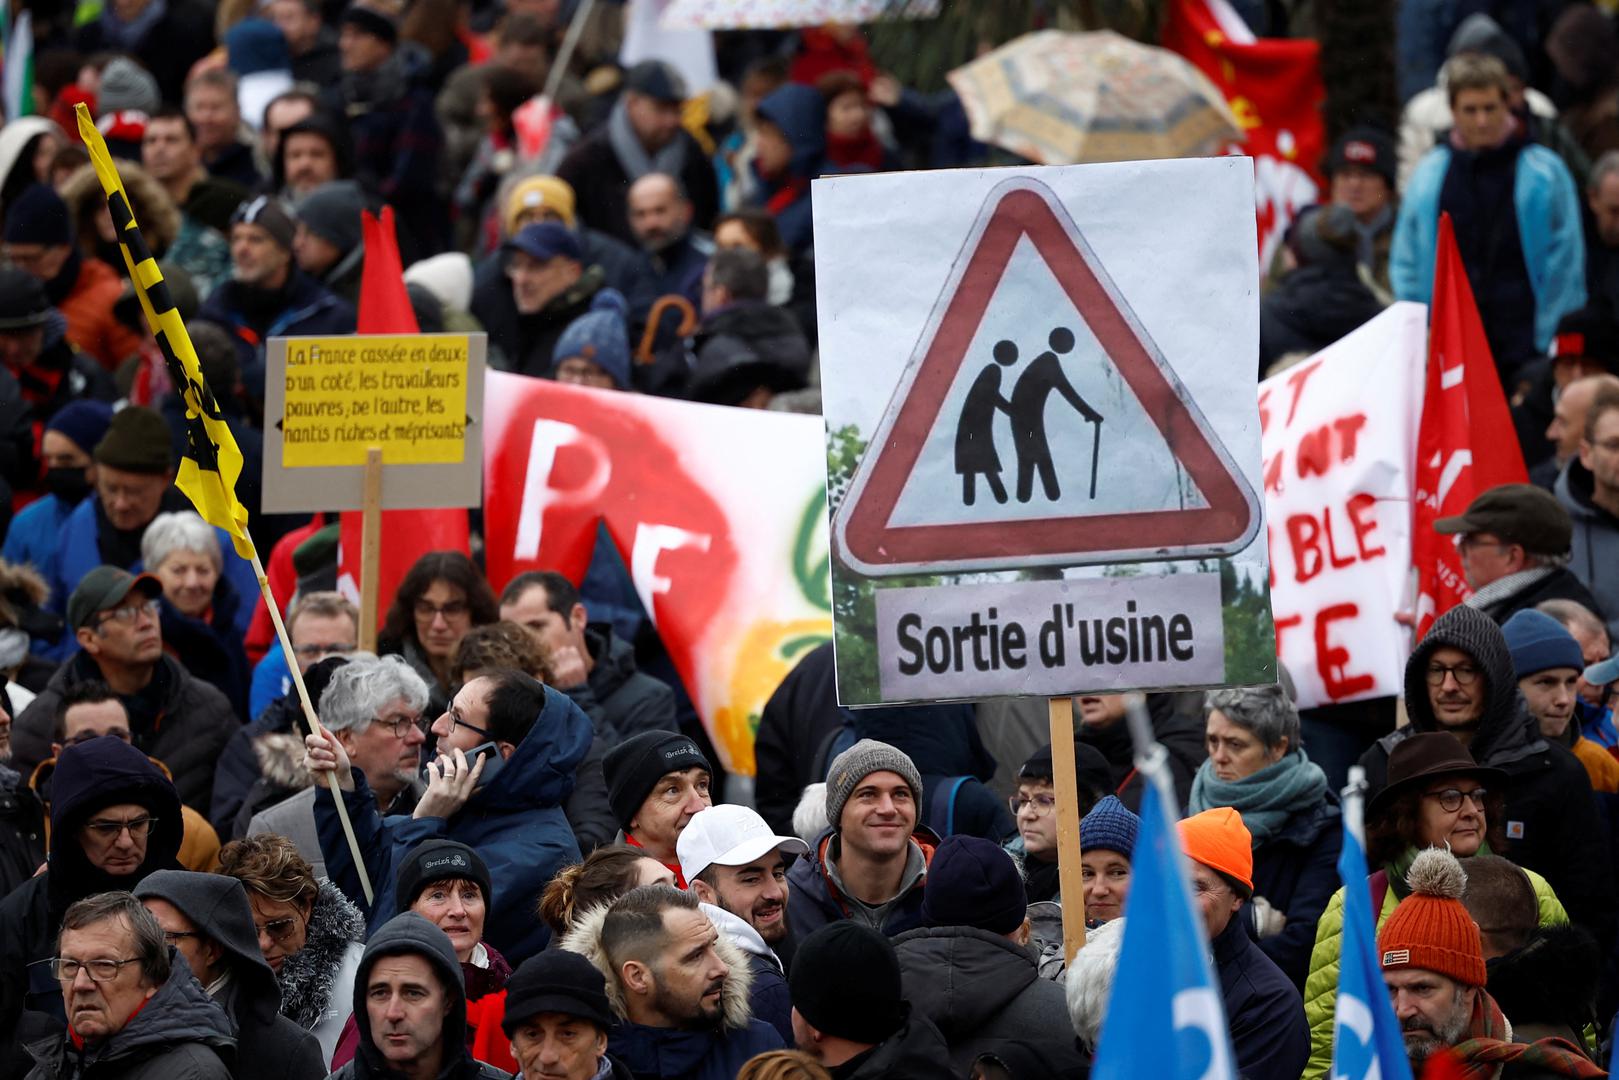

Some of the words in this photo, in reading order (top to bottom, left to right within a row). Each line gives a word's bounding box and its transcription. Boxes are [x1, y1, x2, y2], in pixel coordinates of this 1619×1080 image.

[287, 346, 305, 366] La
[310, 345, 356, 364] France
[360, 344, 407, 364] cassée
[410, 349, 426, 363] en
[359, 370, 379, 391] les
[382, 370, 460, 391] travailleurs
[426, 396, 446, 414] les
[284, 428, 330, 444] nantis
[334, 424, 377, 443] riches
[379, 427, 391, 441] et
[394, 421, 465, 445] méprisants
[897, 607, 1027, 676] Sortie
[1038, 600, 1194, 668] d'usine
